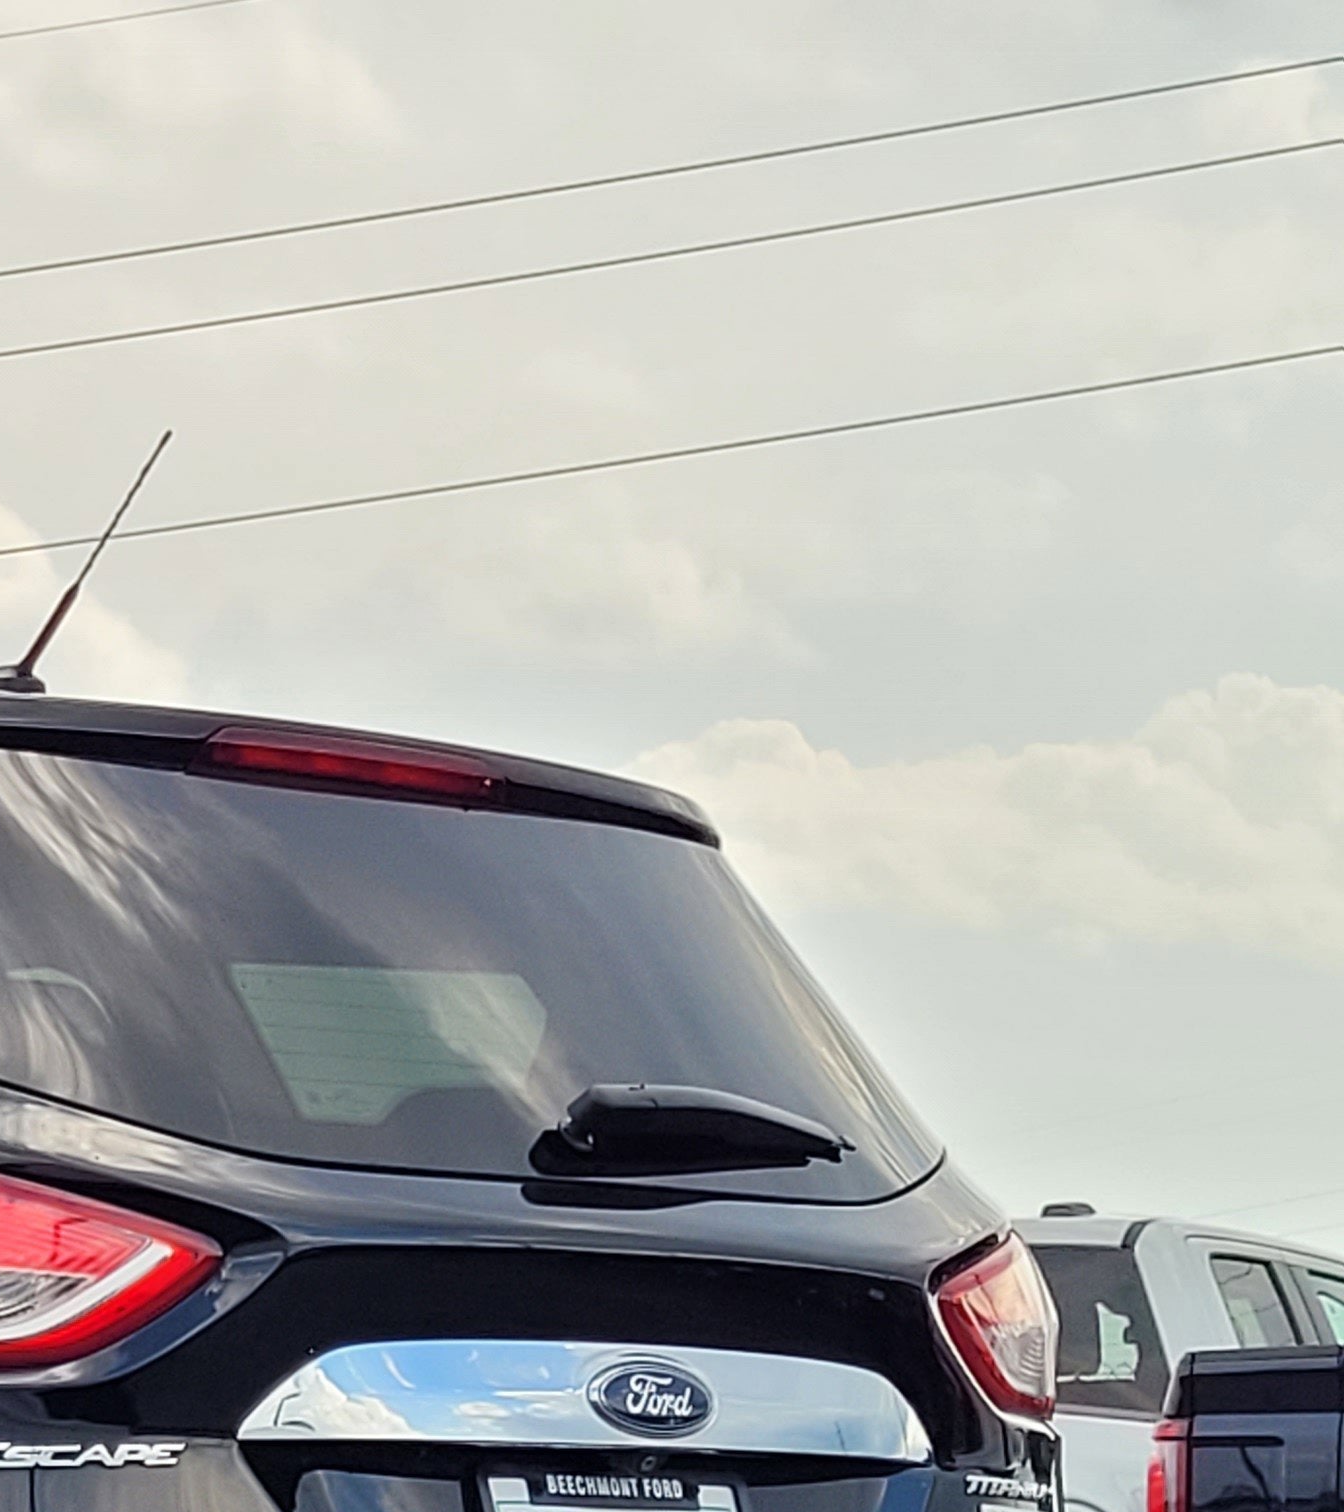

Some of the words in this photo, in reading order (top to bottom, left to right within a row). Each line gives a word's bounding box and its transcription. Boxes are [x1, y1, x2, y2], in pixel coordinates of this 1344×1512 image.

[626, 1374, 693, 1417] Ford
[545, 1473, 639, 1498] BEECHMONT
[642, 1477, 684, 1499] FORD
